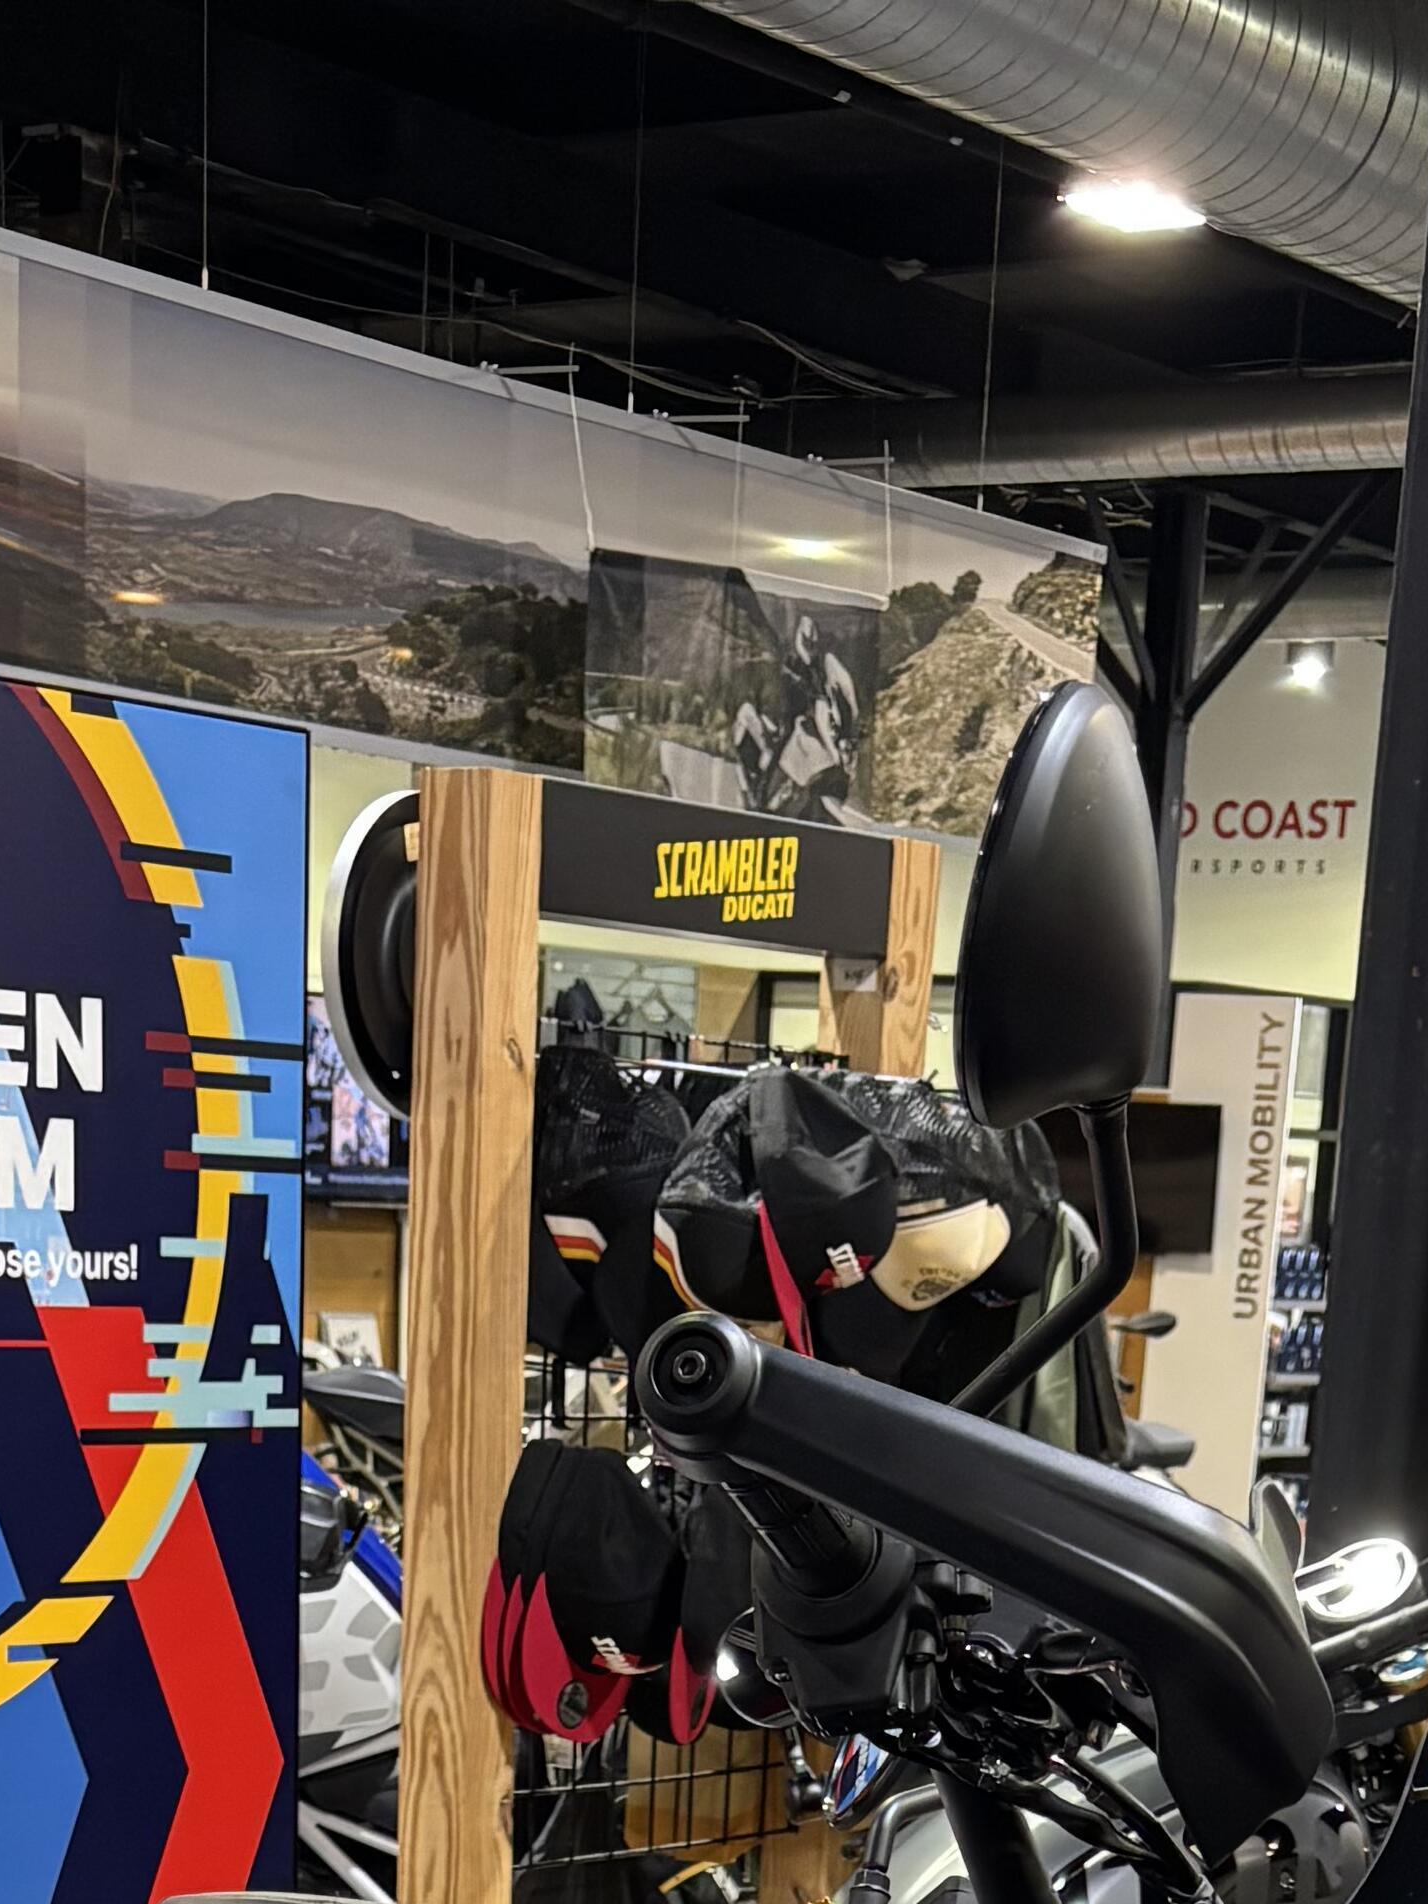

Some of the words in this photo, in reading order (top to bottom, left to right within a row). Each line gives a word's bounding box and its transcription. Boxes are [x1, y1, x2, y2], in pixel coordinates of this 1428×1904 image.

[1213, 799, 1356, 839] COAST
[654, 836, 799, 898] SCRAMBLER
[1190, 859, 1325, 874] RSPORTS
[722, 892, 795, 922] DUCATI
[1246, 1012, 1285, 1187] MOBILITY
[49, 1242, 138, 1291] yours!
[1233, 1199, 1266, 1320] URBAN
